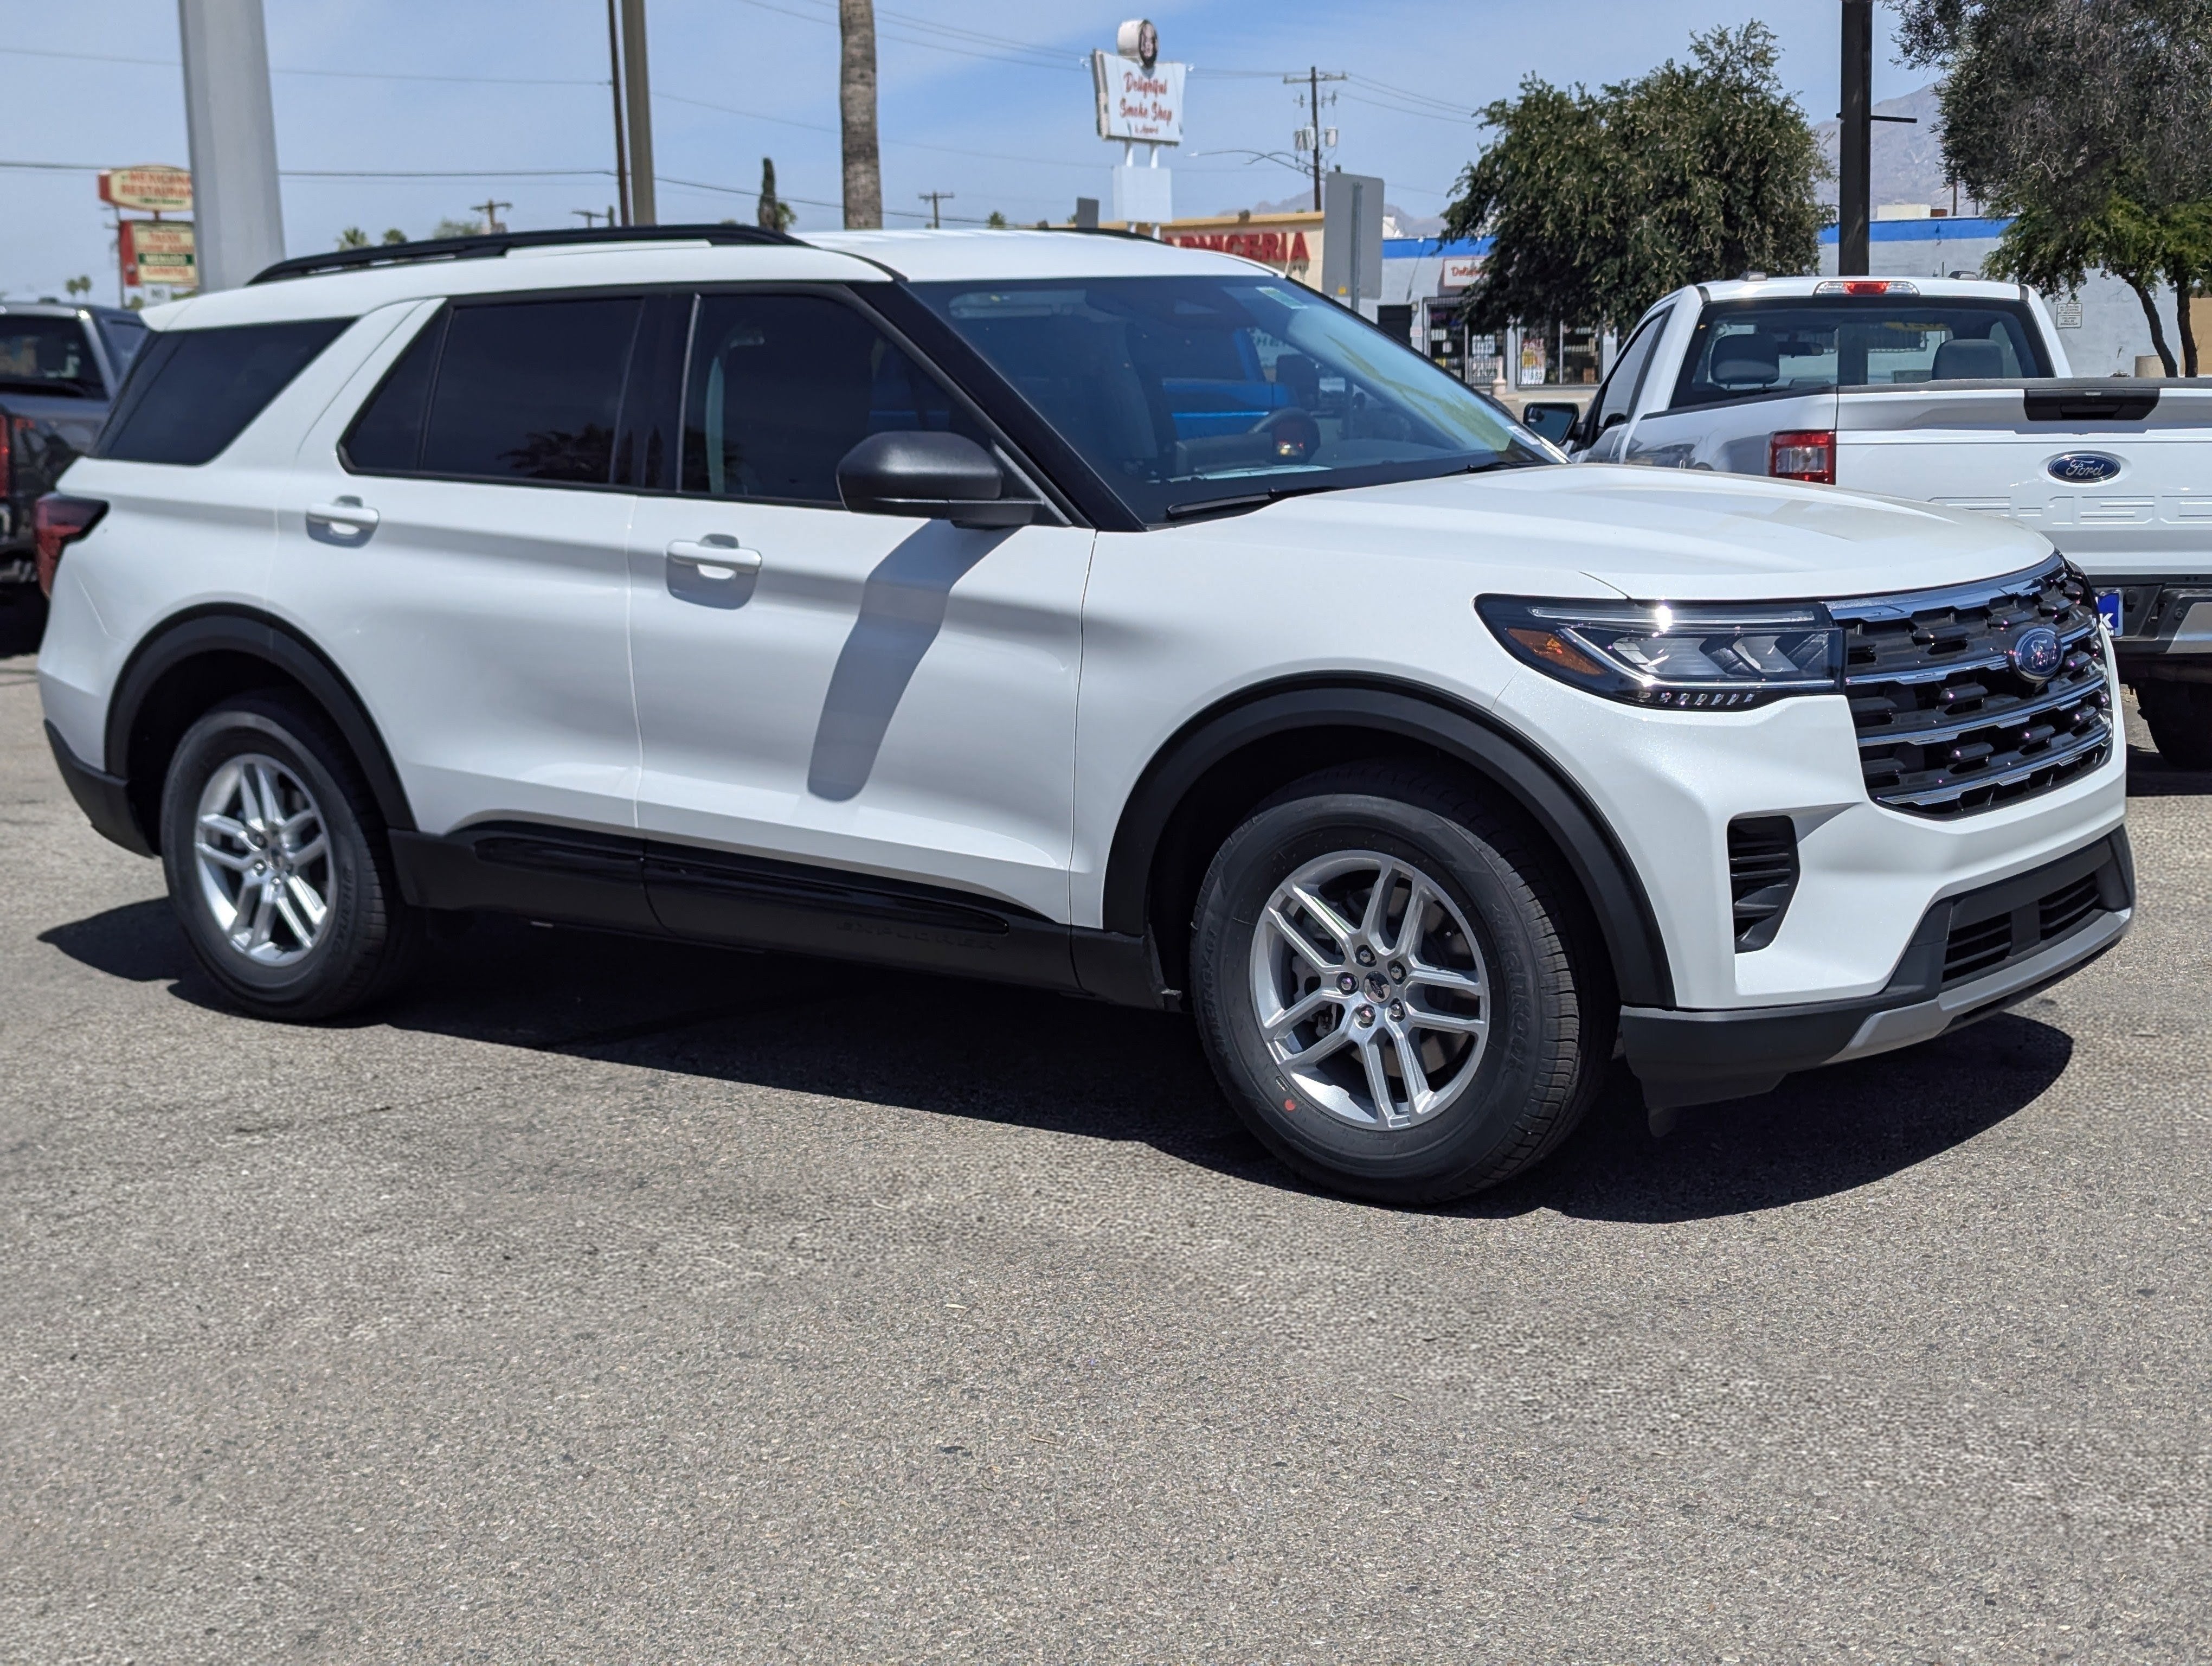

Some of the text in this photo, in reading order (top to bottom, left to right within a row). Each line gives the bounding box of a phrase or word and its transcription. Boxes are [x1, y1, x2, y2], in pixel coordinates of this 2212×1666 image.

[1120, 98, 1172, 127] Smoke Shop
[2066, 459, 2105, 476] Ford
[2030, 639, 2058, 669] Ford
